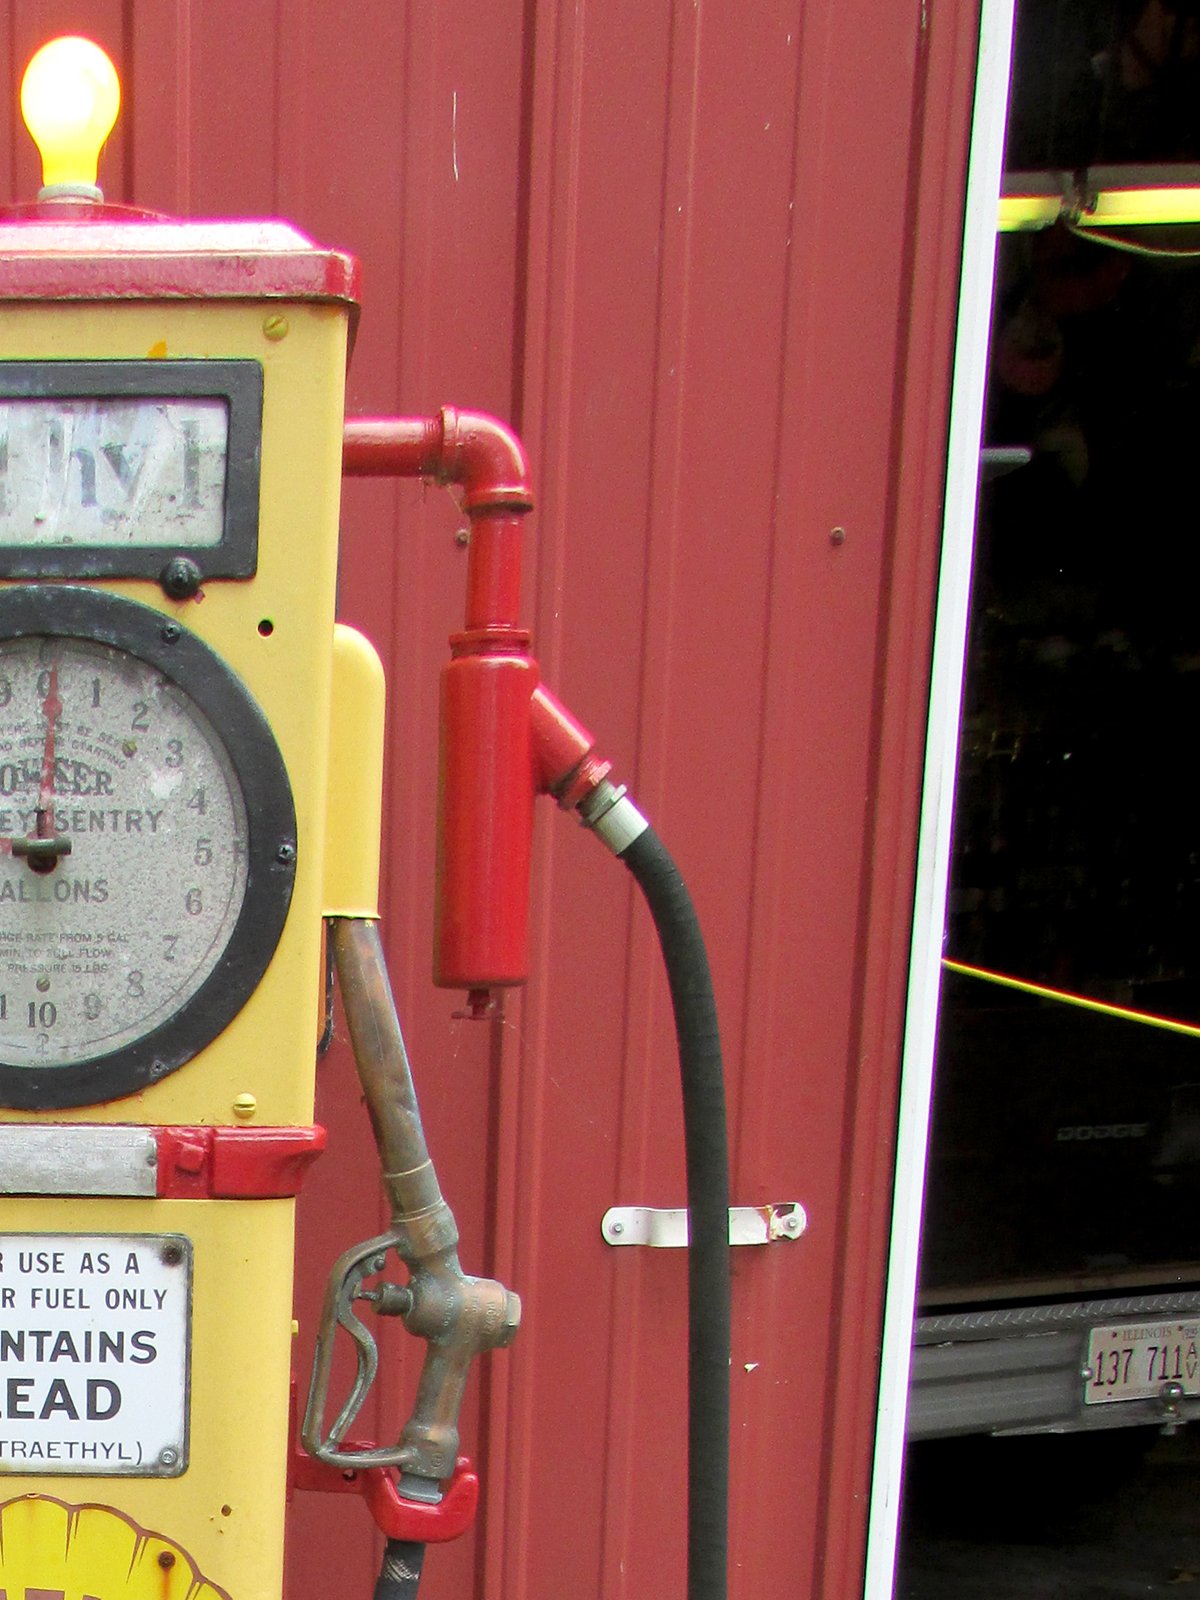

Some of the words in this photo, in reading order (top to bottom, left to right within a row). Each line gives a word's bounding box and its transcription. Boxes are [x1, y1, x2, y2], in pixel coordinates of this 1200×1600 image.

[91, 678, 100, 708] 1
[131, 701, 149, 732] 2
[165, 739, 184, 769] 3
[186, 787, 206, 815] 4
[53, 809, 163, 833] SENTRY
[194, 838, 213, 866] 5
[186, 887, 203, 916] 6
[162, 934, 179, 961] 7
[126, 970, 144, 997] 8
[27, 1001, 57, 1028] 10
[84, 993, 100, 1020] 9
[1057, 1123, 1147, 1141] DODGE
[19, 1252, 65, 1274] USE
[79, 1253, 111, 1274] AS
[125, 1253, 140, 1275] A
[31, 1288, 90, 1310] FUEL
[105, 1289, 168, 1310] ONLY
[1122, 1327, 1171, 1340] ILLINOIS
[1093, 1348, 1134, 1386] 137
[1147, 1345, 1182, 1381] 711
